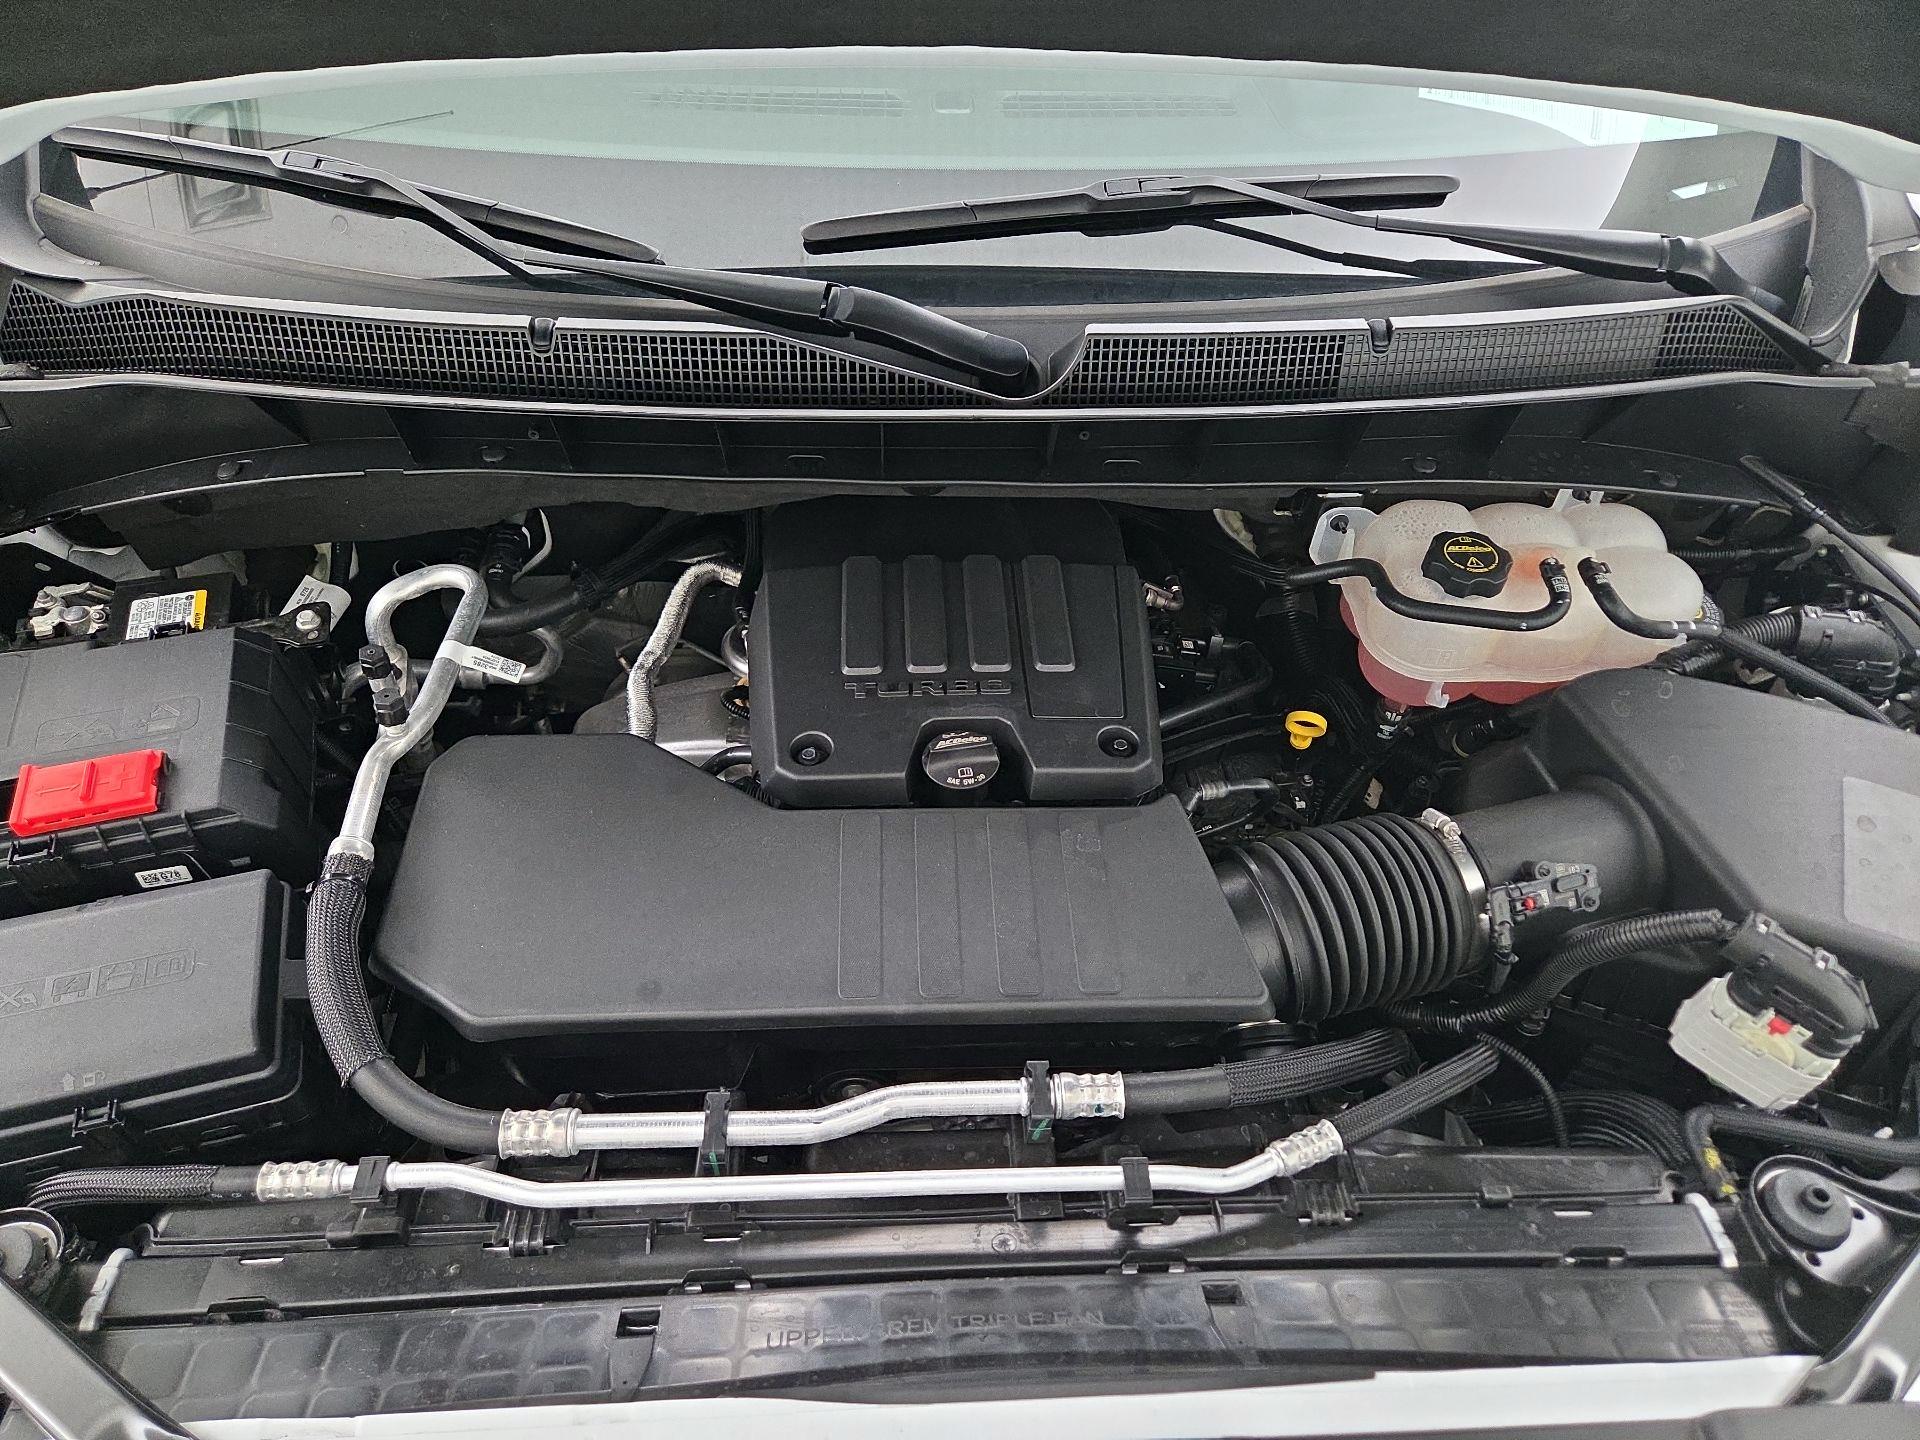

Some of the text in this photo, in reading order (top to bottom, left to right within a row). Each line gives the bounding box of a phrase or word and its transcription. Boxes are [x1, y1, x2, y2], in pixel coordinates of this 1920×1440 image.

[844, 679, 1012, 699] TURBO
[934, 736, 988, 750] ACDelco
[946, 773, 986, 786] SAE 5W-30
